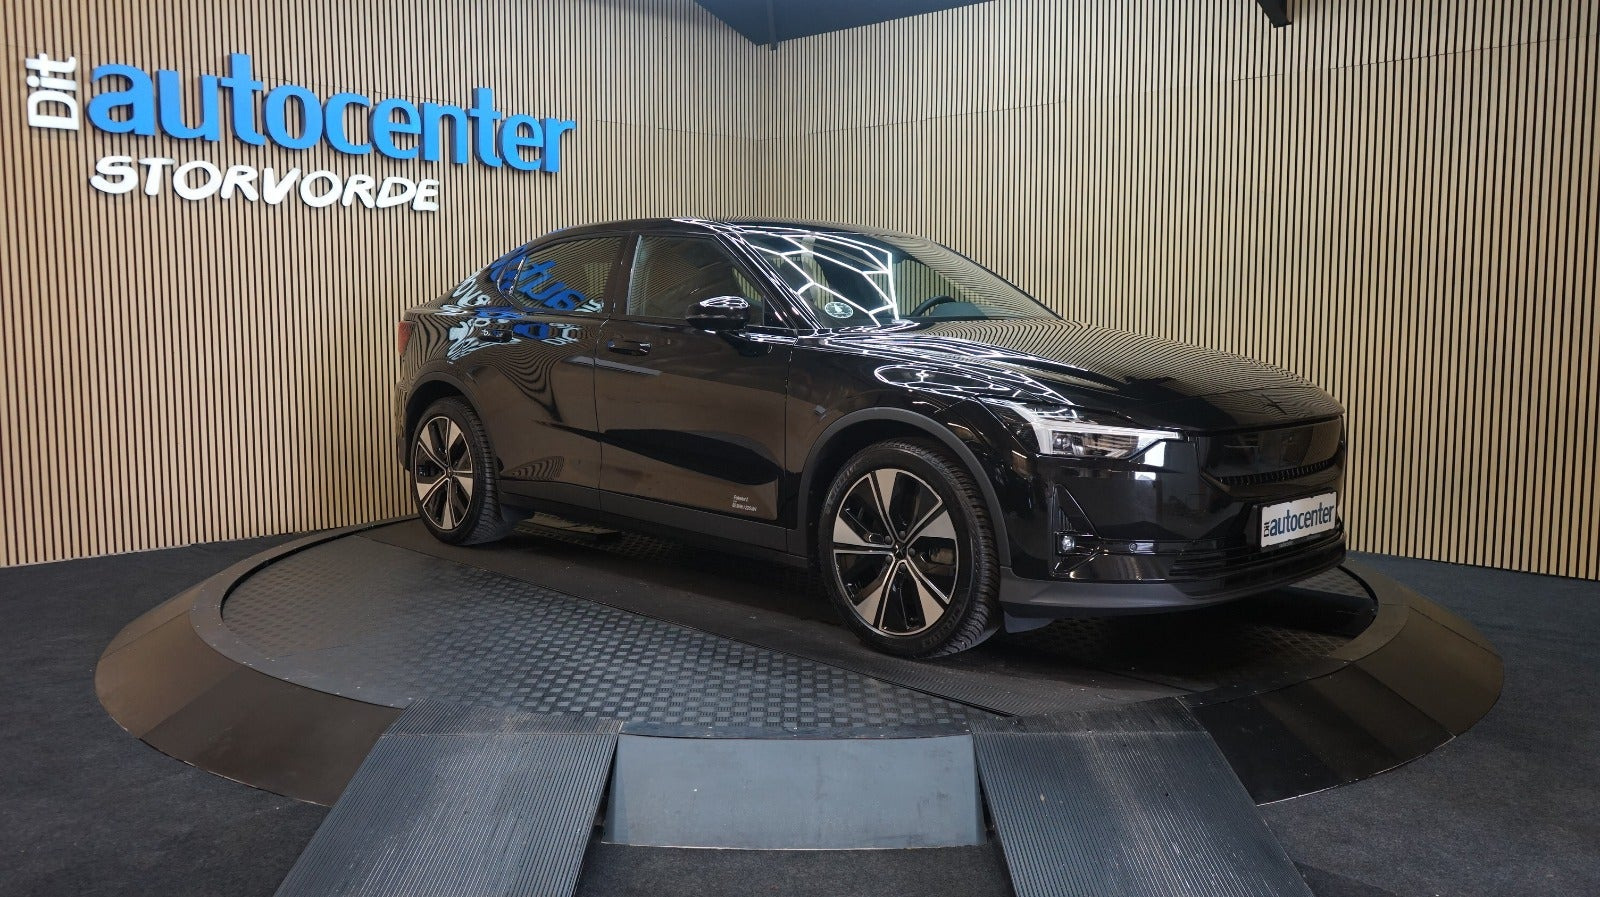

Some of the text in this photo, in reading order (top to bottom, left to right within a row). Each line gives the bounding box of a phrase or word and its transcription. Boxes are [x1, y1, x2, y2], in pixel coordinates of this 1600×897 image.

[25, 53, 576, 172] Dit autocenter
[90, 155, 440, 212] STORVORDE
[1270, 502, 1334, 536] autocenter
